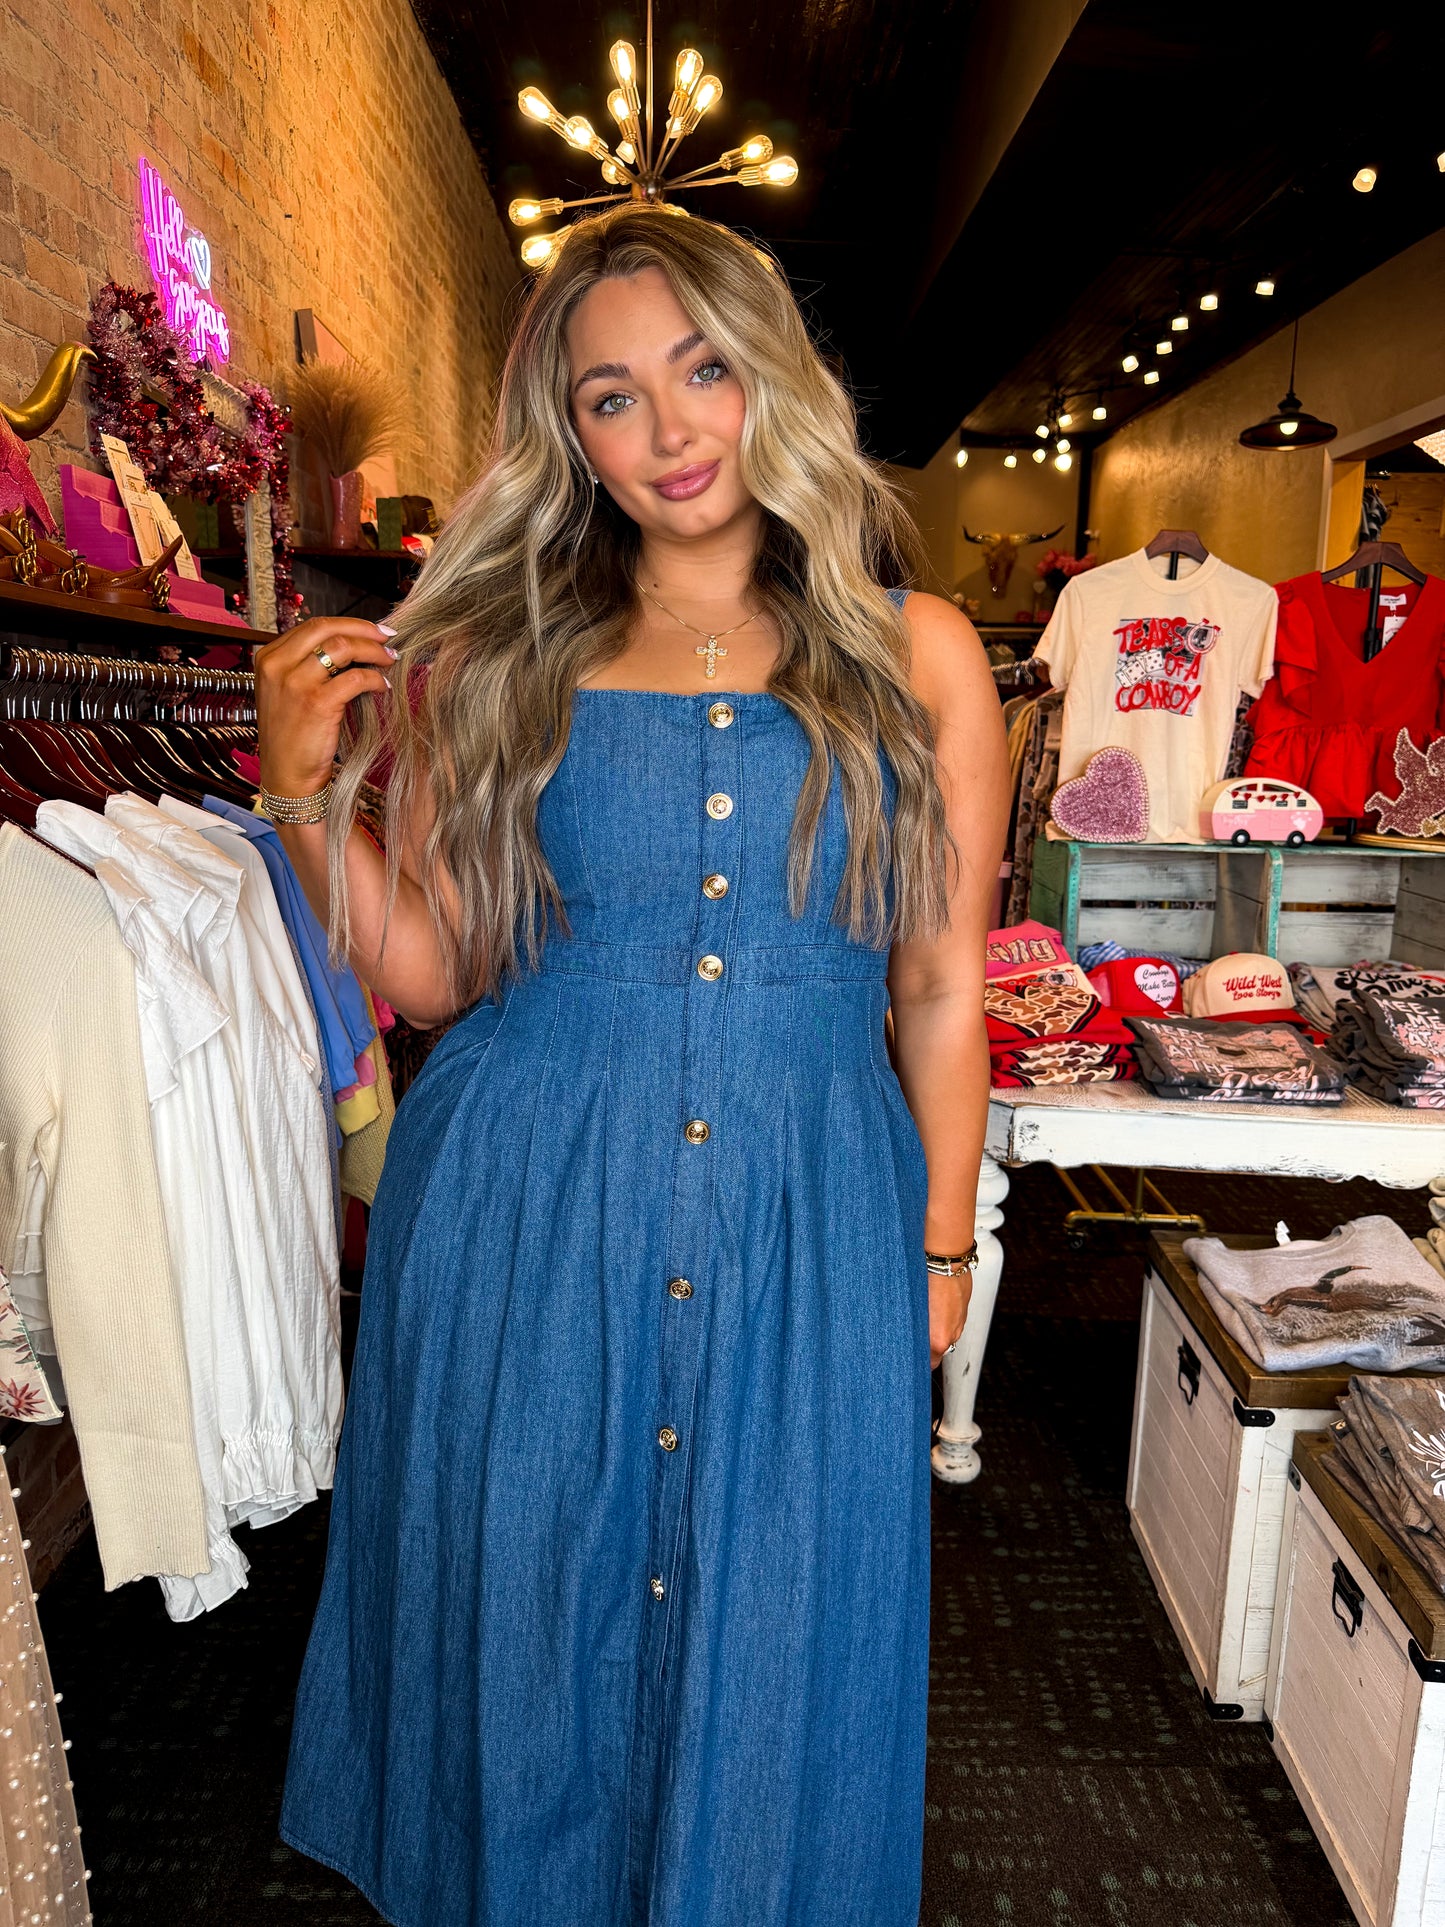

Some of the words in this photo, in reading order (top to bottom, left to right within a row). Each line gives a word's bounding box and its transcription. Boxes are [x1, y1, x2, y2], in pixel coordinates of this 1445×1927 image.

[142, 160, 196, 278] Hello
[1113, 617, 1187, 653] TEARS
[1165, 652, 1187, 676] OF
[1183, 653, 1202, 681] A
[1115, 680, 1202, 714] COWBOY
[1137, 981, 1161, 992] Make
[1223, 975, 1256, 992] Wild
[1258, 974, 1282, 988] West
[1233, 991, 1254, 1001] Love
[1168, 1045, 1193, 1058] AT
